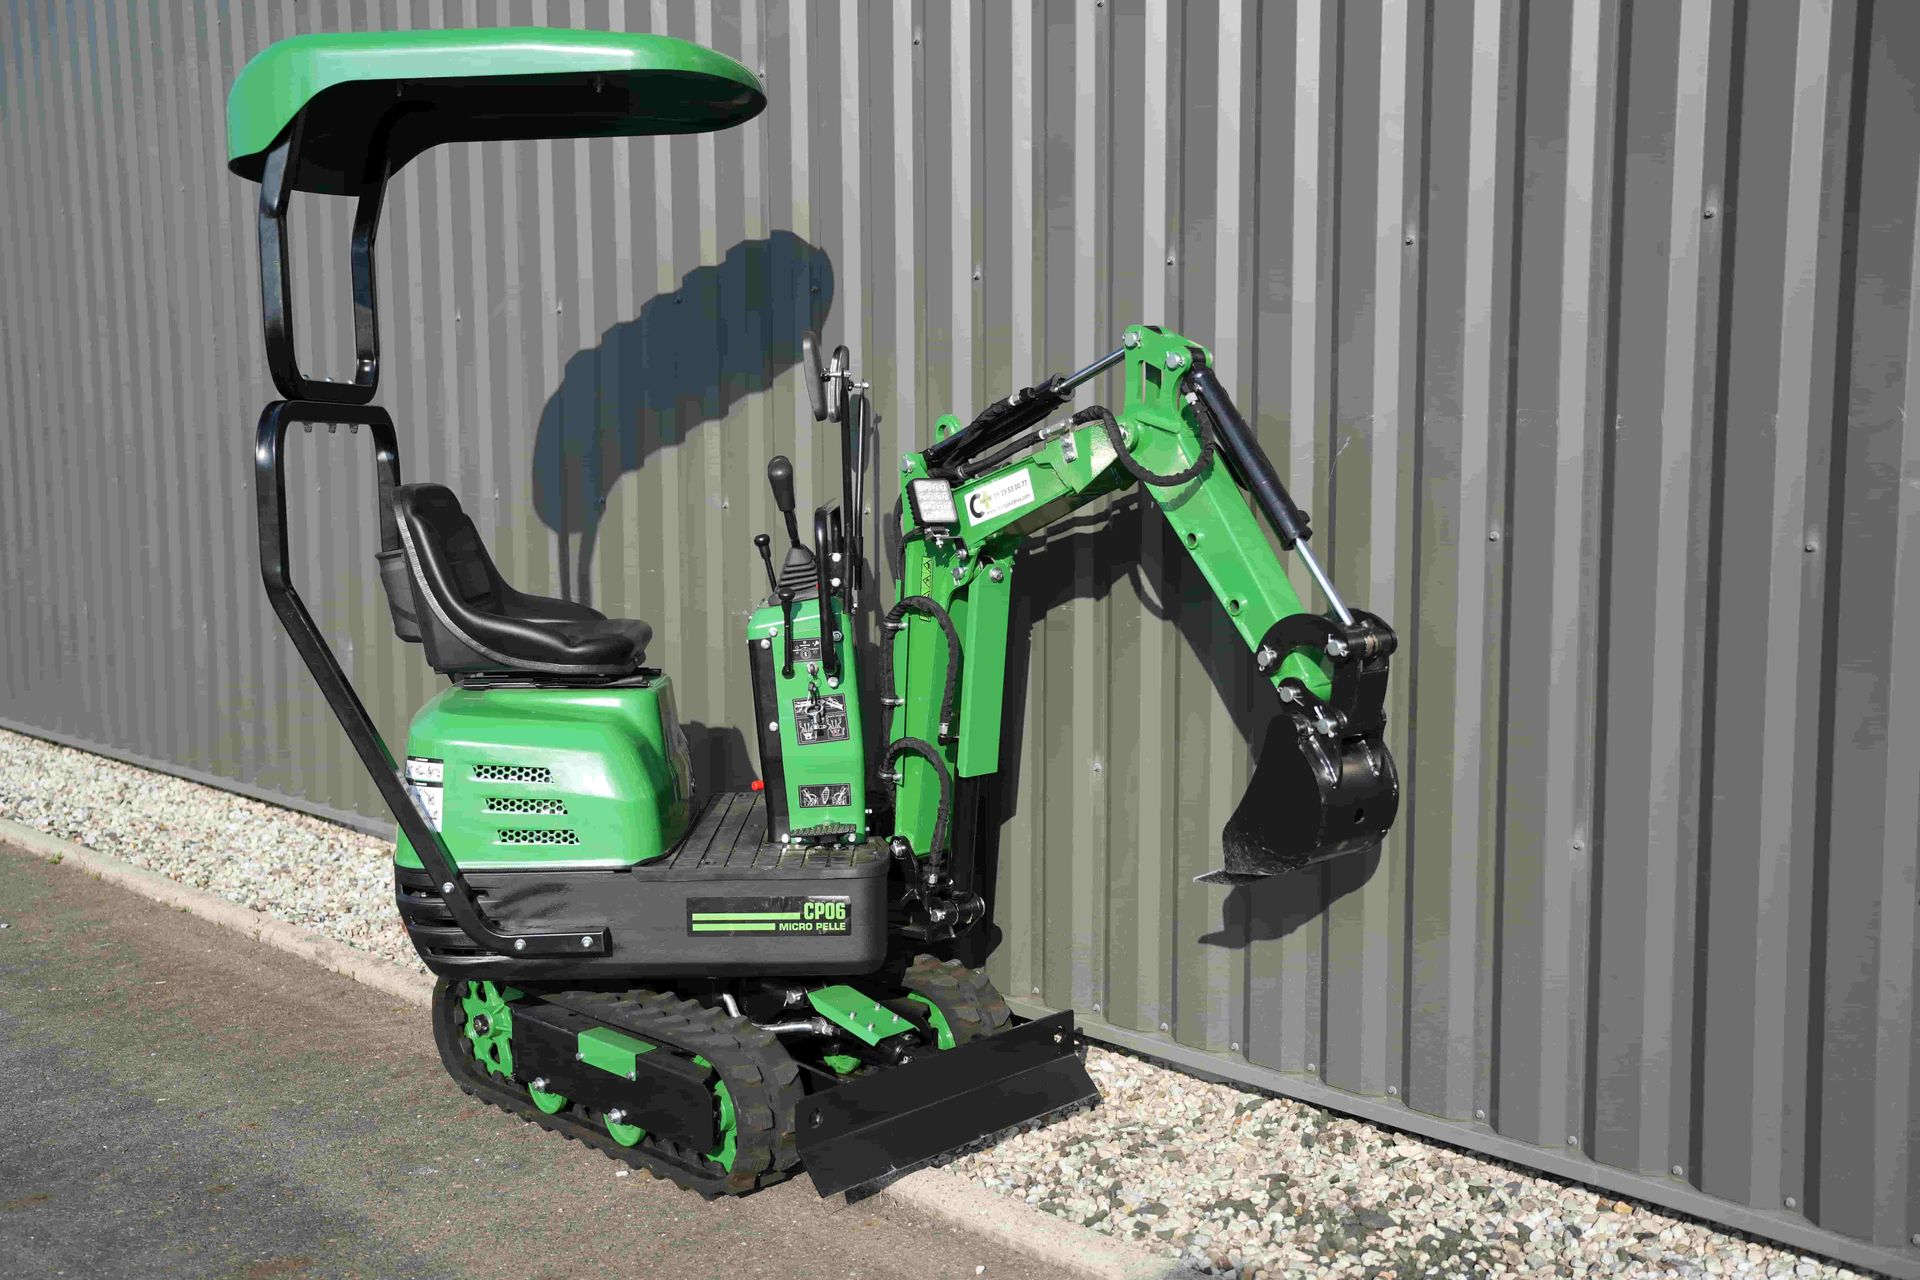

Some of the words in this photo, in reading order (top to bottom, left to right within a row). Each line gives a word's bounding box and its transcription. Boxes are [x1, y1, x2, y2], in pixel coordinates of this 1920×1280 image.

[1014, 482, 1021, 490] 00
[803, 902, 846, 920] CP06
[779, 922, 813, 931] MICRO
[815, 922, 846, 931] PELLE
